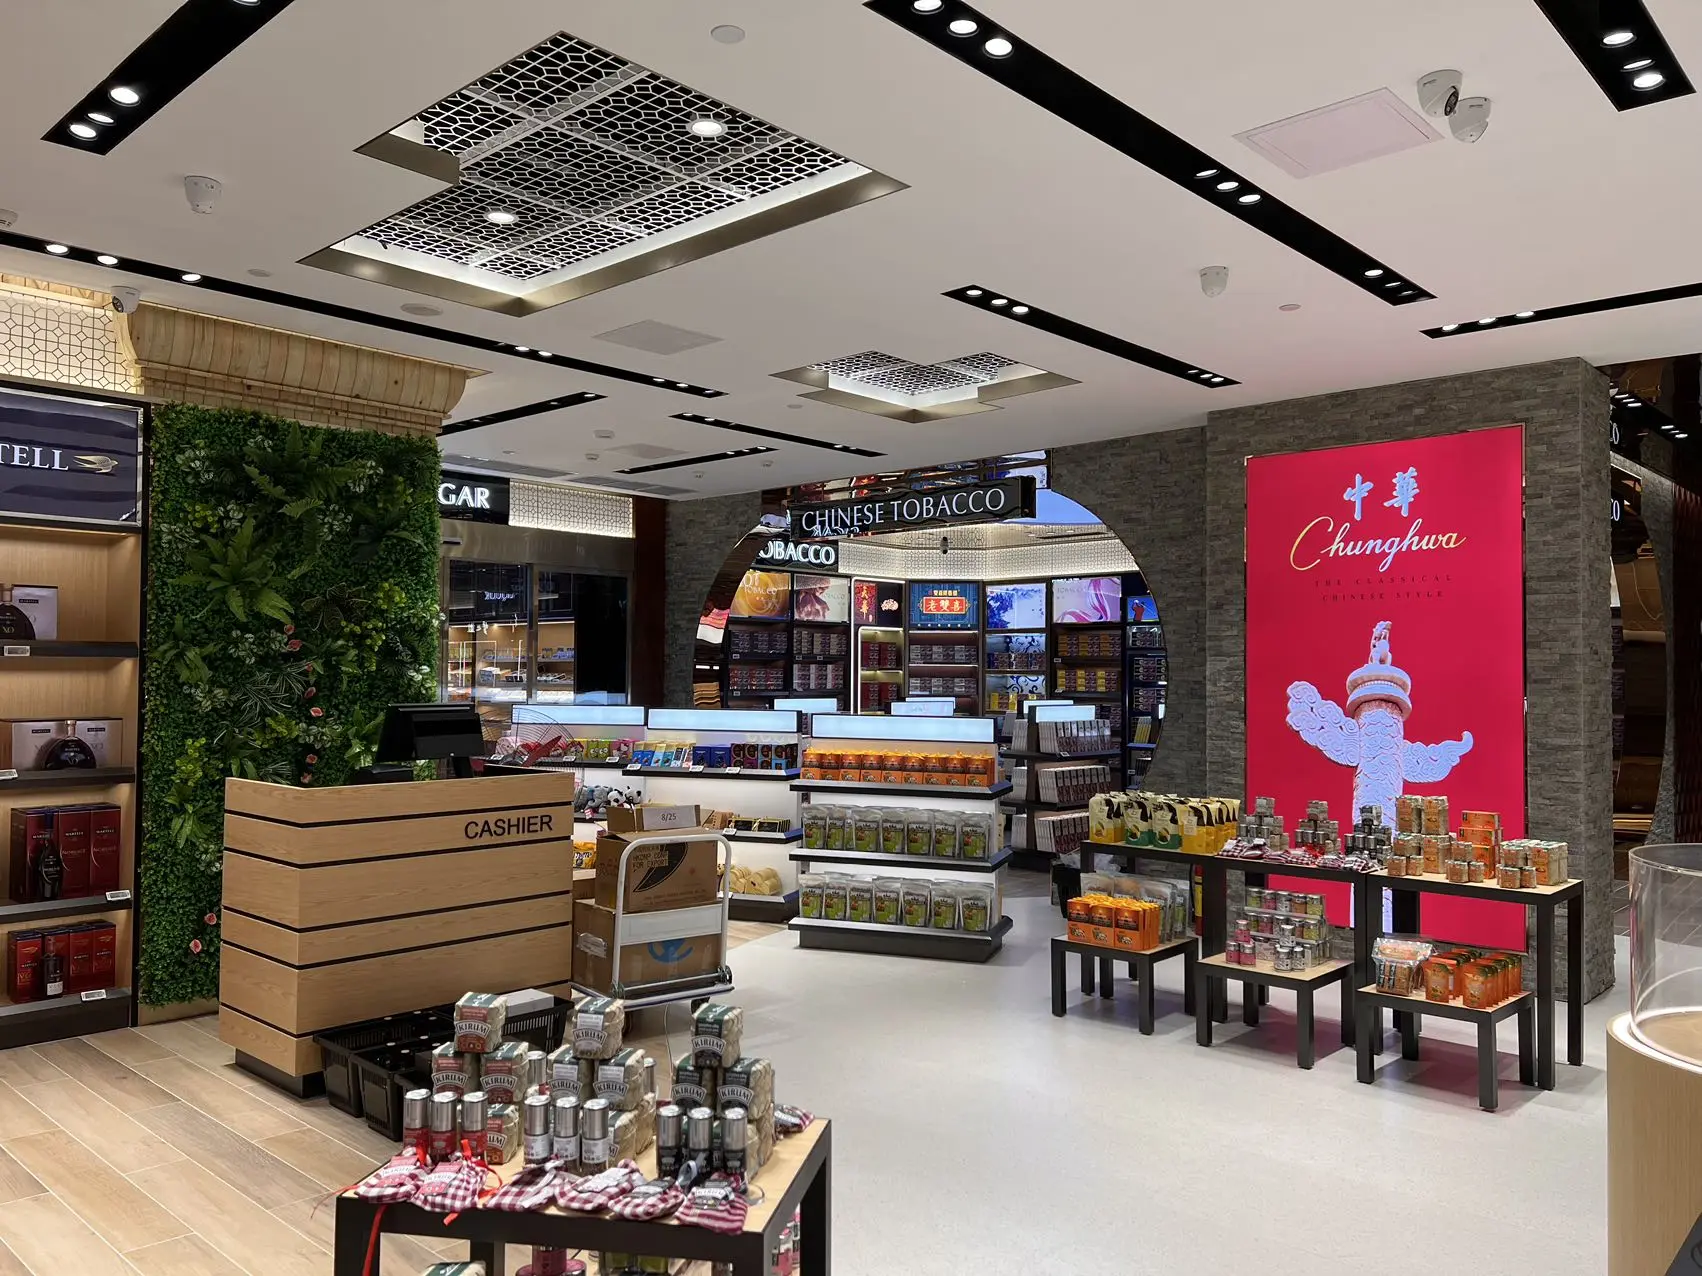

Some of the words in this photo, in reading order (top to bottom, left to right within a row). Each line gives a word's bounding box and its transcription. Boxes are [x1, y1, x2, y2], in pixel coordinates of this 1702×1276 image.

[0, 443, 69, 471] TELL
[437, 483, 490, 509] GAR
[1343, 467, 1420, 521] 中華
[802, 503, 884, 531] CHINESE
[890, 488, 1005, 521] TOBACCO
[1290, 516, 1467, 572] Chunghwa
[1314, 579, 1343, 587] THE
[1355, 575, 1453, 585] CLASSICAL
[1322, 593, 1385, 602] CHINESE
[1395, 591, 1444, 599] STYLE
[464, 814, 553, 840] CASHIER
[661, 812, 677, 821] 8/25
